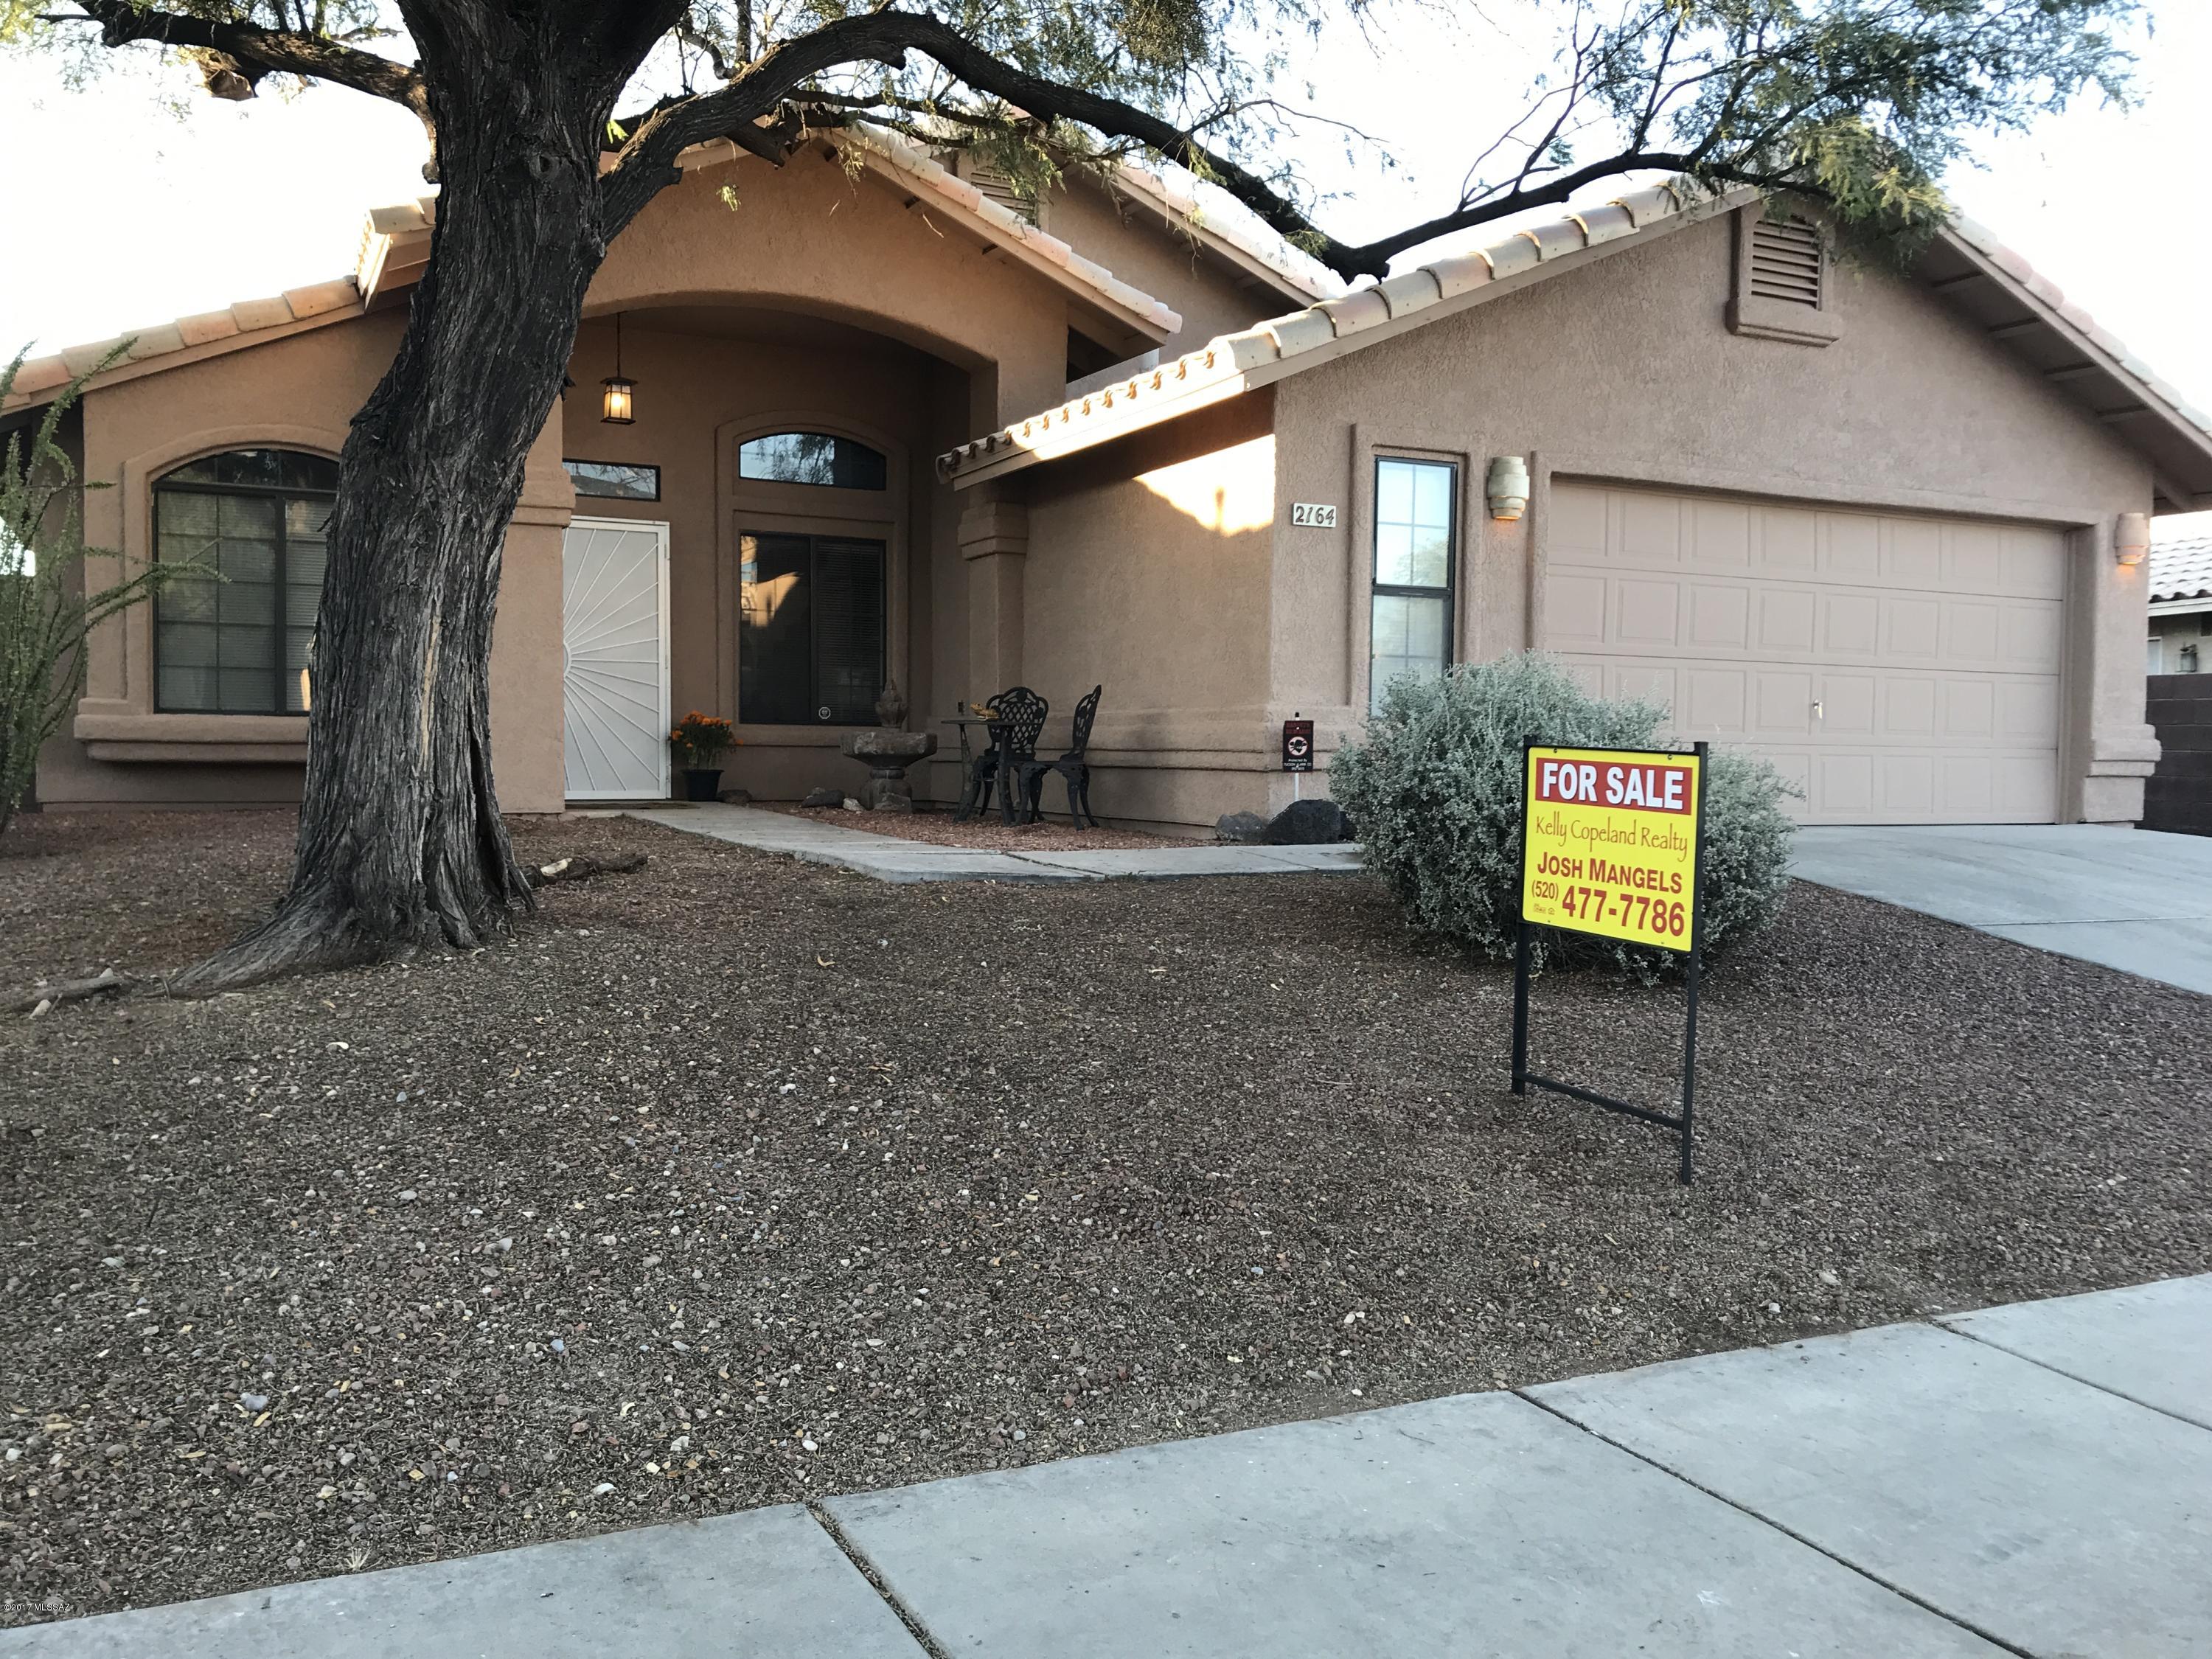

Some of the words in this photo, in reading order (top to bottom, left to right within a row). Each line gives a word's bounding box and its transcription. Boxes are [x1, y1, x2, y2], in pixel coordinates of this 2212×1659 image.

[1295, 506, 1334, 525] 2164
[1543, 762, 1597, 802] FOR
[1606, 766, 1684, 810] SALE
[1536, 811, 1568, 847] Kelly
[1571, 816, 1637, 852] Copeland
[1641, 823, 1688, 863] Realty
[1537, 852, 1583, 879] JOSH
[1589, 858, 1683, 894] MANGELS
[1531, 880, 1559, 901] (520)
[1562, 885, 1685, 937] 477-7786
